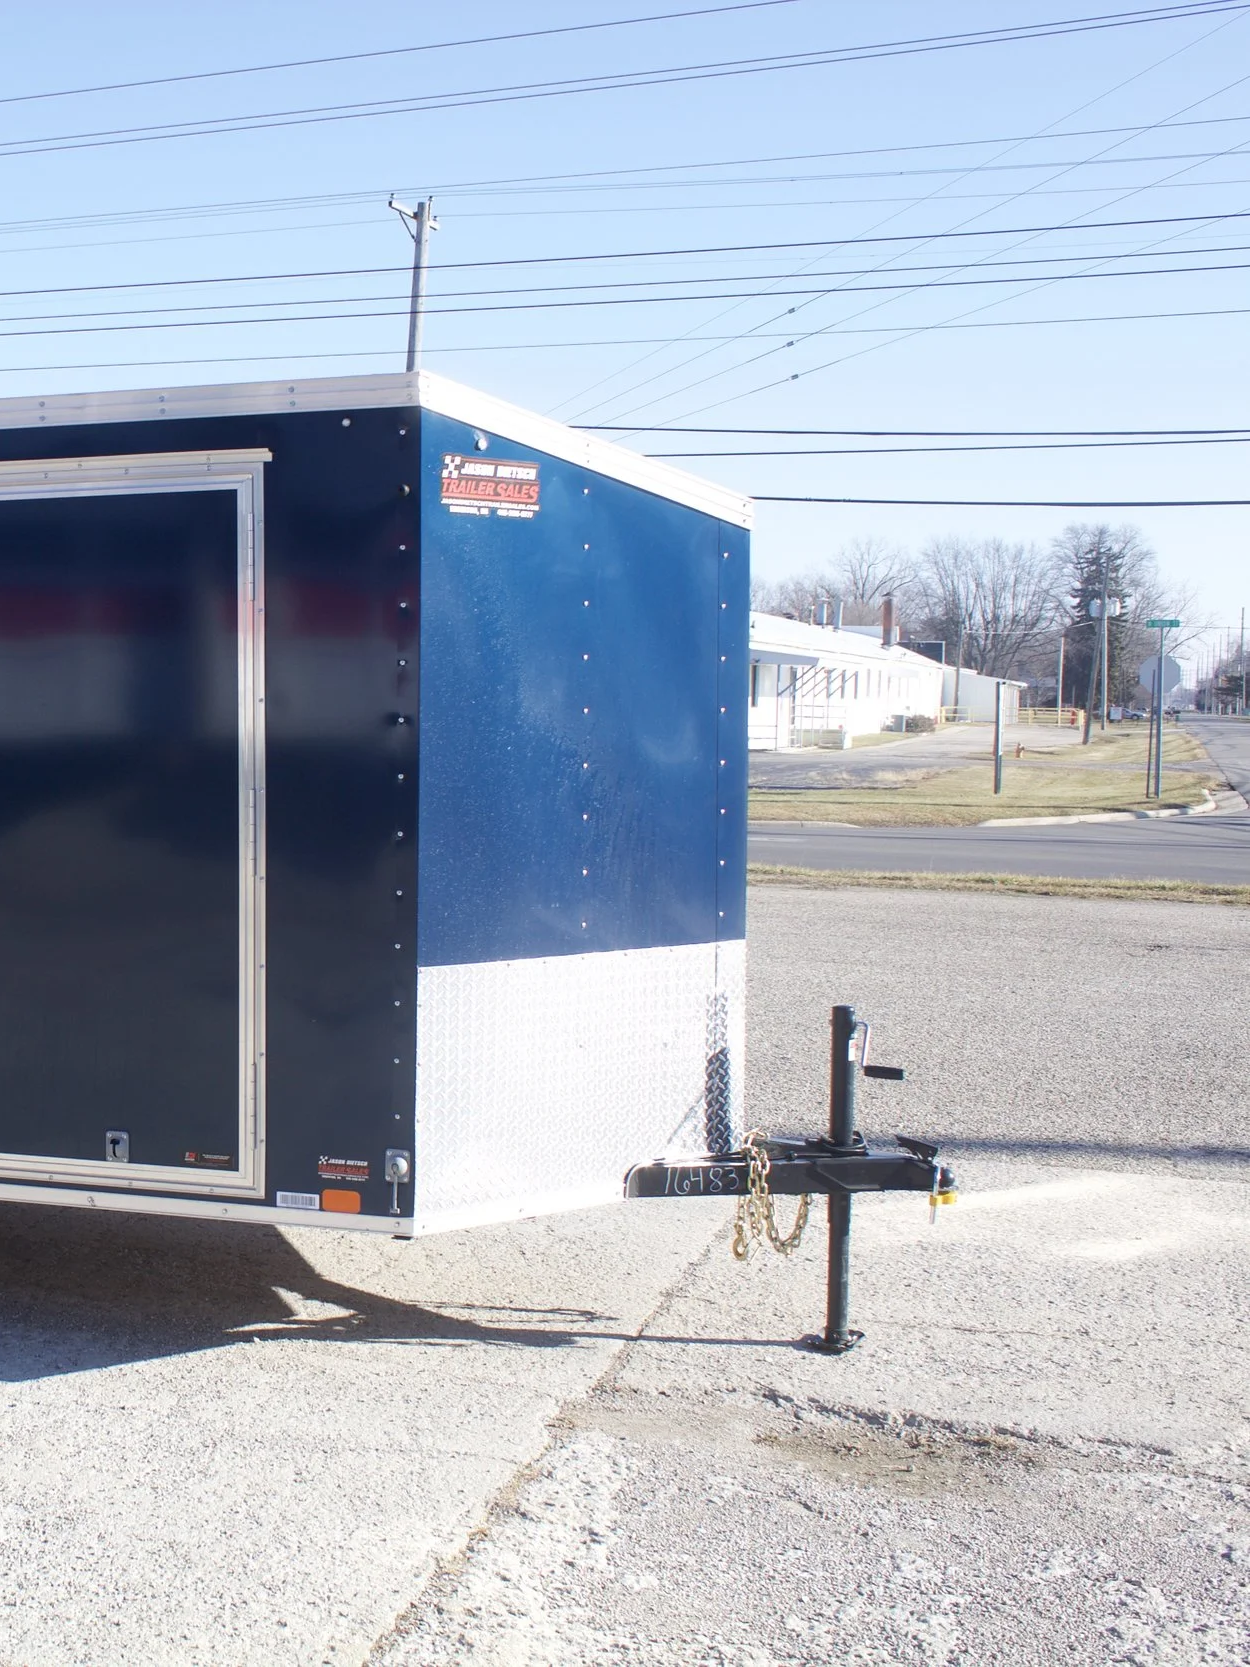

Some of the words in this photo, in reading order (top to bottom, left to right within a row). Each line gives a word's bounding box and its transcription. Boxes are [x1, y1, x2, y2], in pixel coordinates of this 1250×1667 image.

[442, 478, 497, 496] TRAILER
[496, 482, 540, 503] SALES
[665, 1166, 739, 1195] 16483
